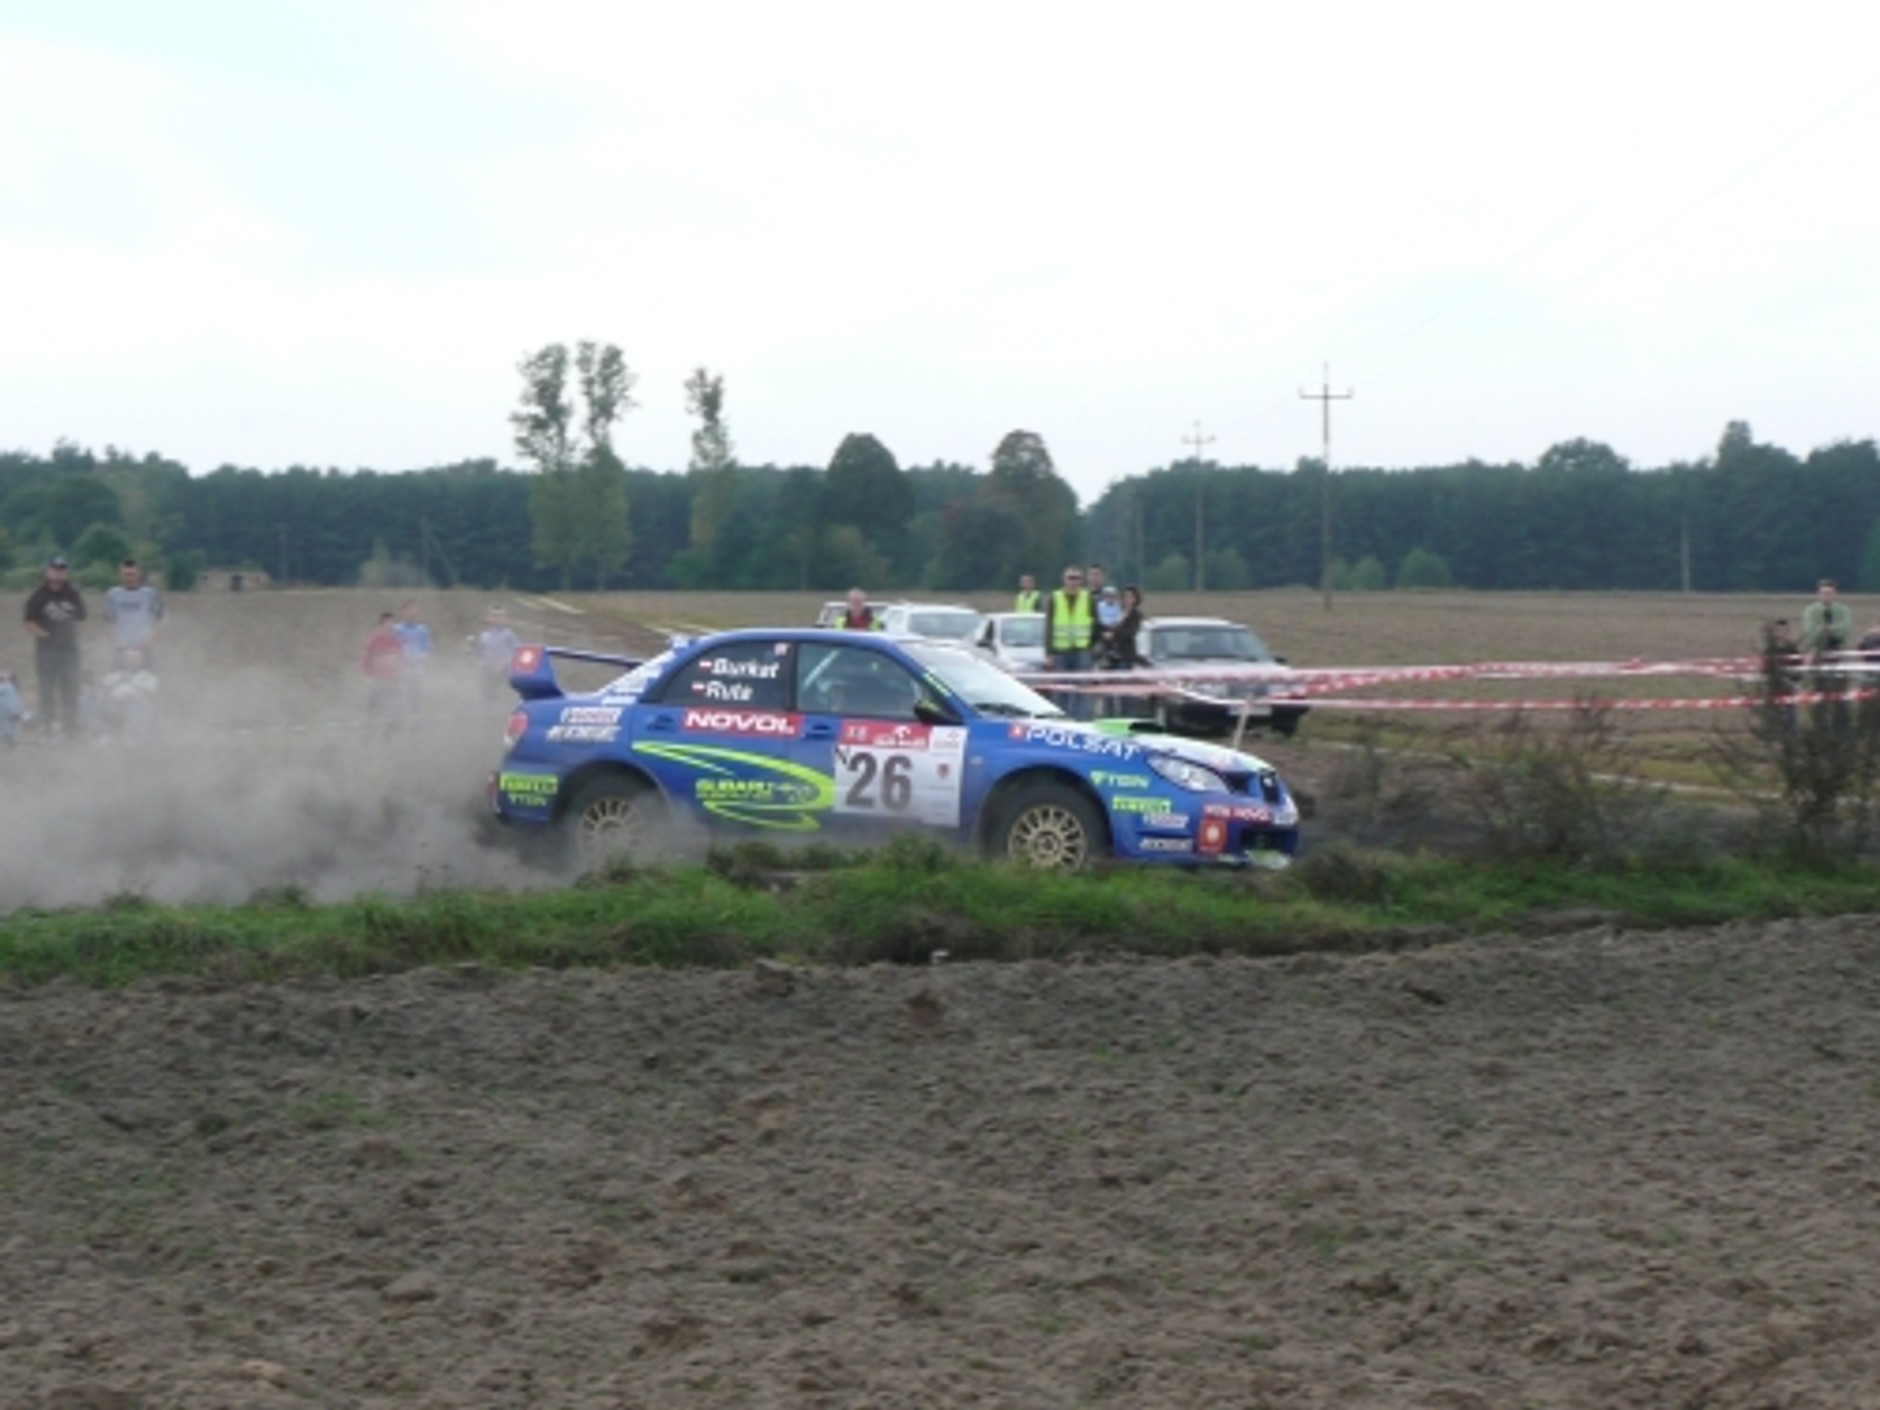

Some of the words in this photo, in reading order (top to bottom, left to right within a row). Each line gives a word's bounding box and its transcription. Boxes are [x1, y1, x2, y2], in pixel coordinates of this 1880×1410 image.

[684, 710, 796, 735] NOVOL
[1025, 725, 1141, 761] POLSAT
[695, 779, 774, 795] SUBARU
[845, 751, 912, 813] 26
